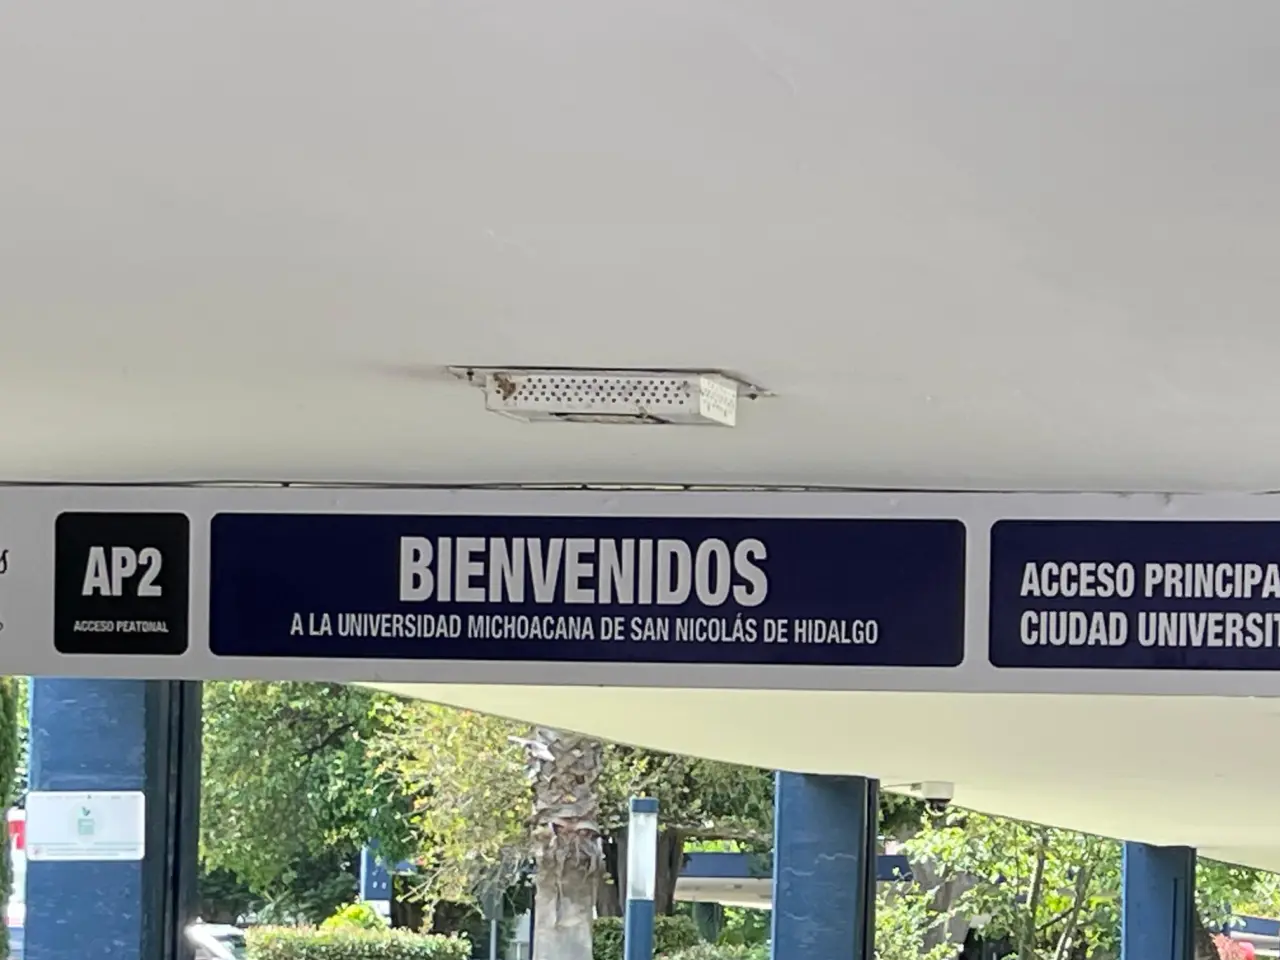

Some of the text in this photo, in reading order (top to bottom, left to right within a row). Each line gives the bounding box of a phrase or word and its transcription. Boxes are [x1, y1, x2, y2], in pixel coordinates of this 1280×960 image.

[82, 546, 162, 597] AP2
[400, 536, 768, 607] BIENVENIDOS
[1020, 562, 1135, 598] ACCESO
[73, 620, 169, 633] ACCESO PEATONAL
[290, 612, 879, 644] A LA UNIVERSIDAD MICHOACANA DE SAN NICOLÁS DE HIDALGO
[1020, 610, 1128, 646] CIUDAD
